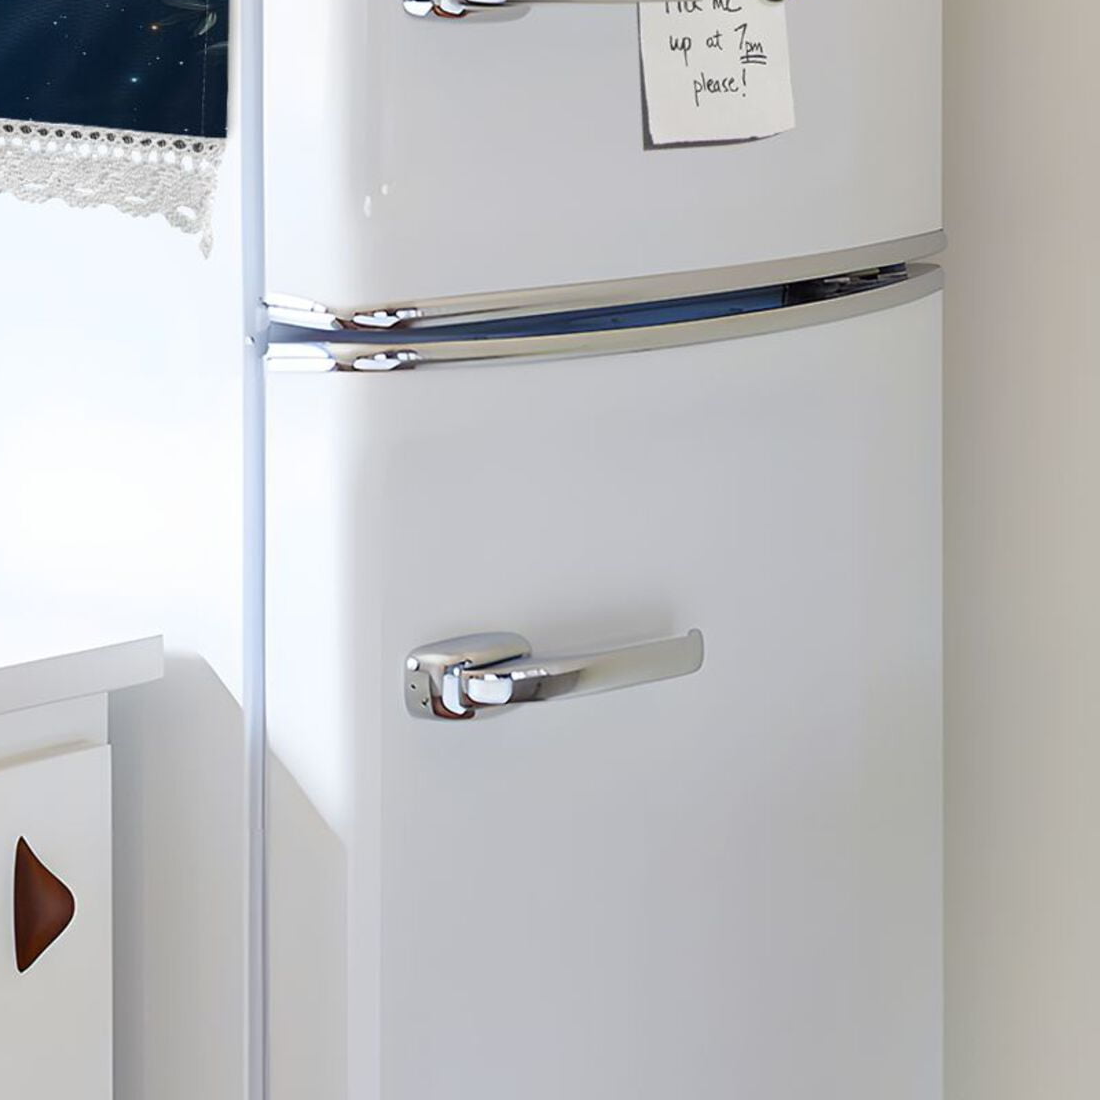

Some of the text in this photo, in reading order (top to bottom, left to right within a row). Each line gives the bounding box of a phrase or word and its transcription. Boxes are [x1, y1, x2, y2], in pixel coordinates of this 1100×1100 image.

[669, 34, 692, 66] up
[706, 30, 723, 51] at
[693, 68, 747, 107] please!
